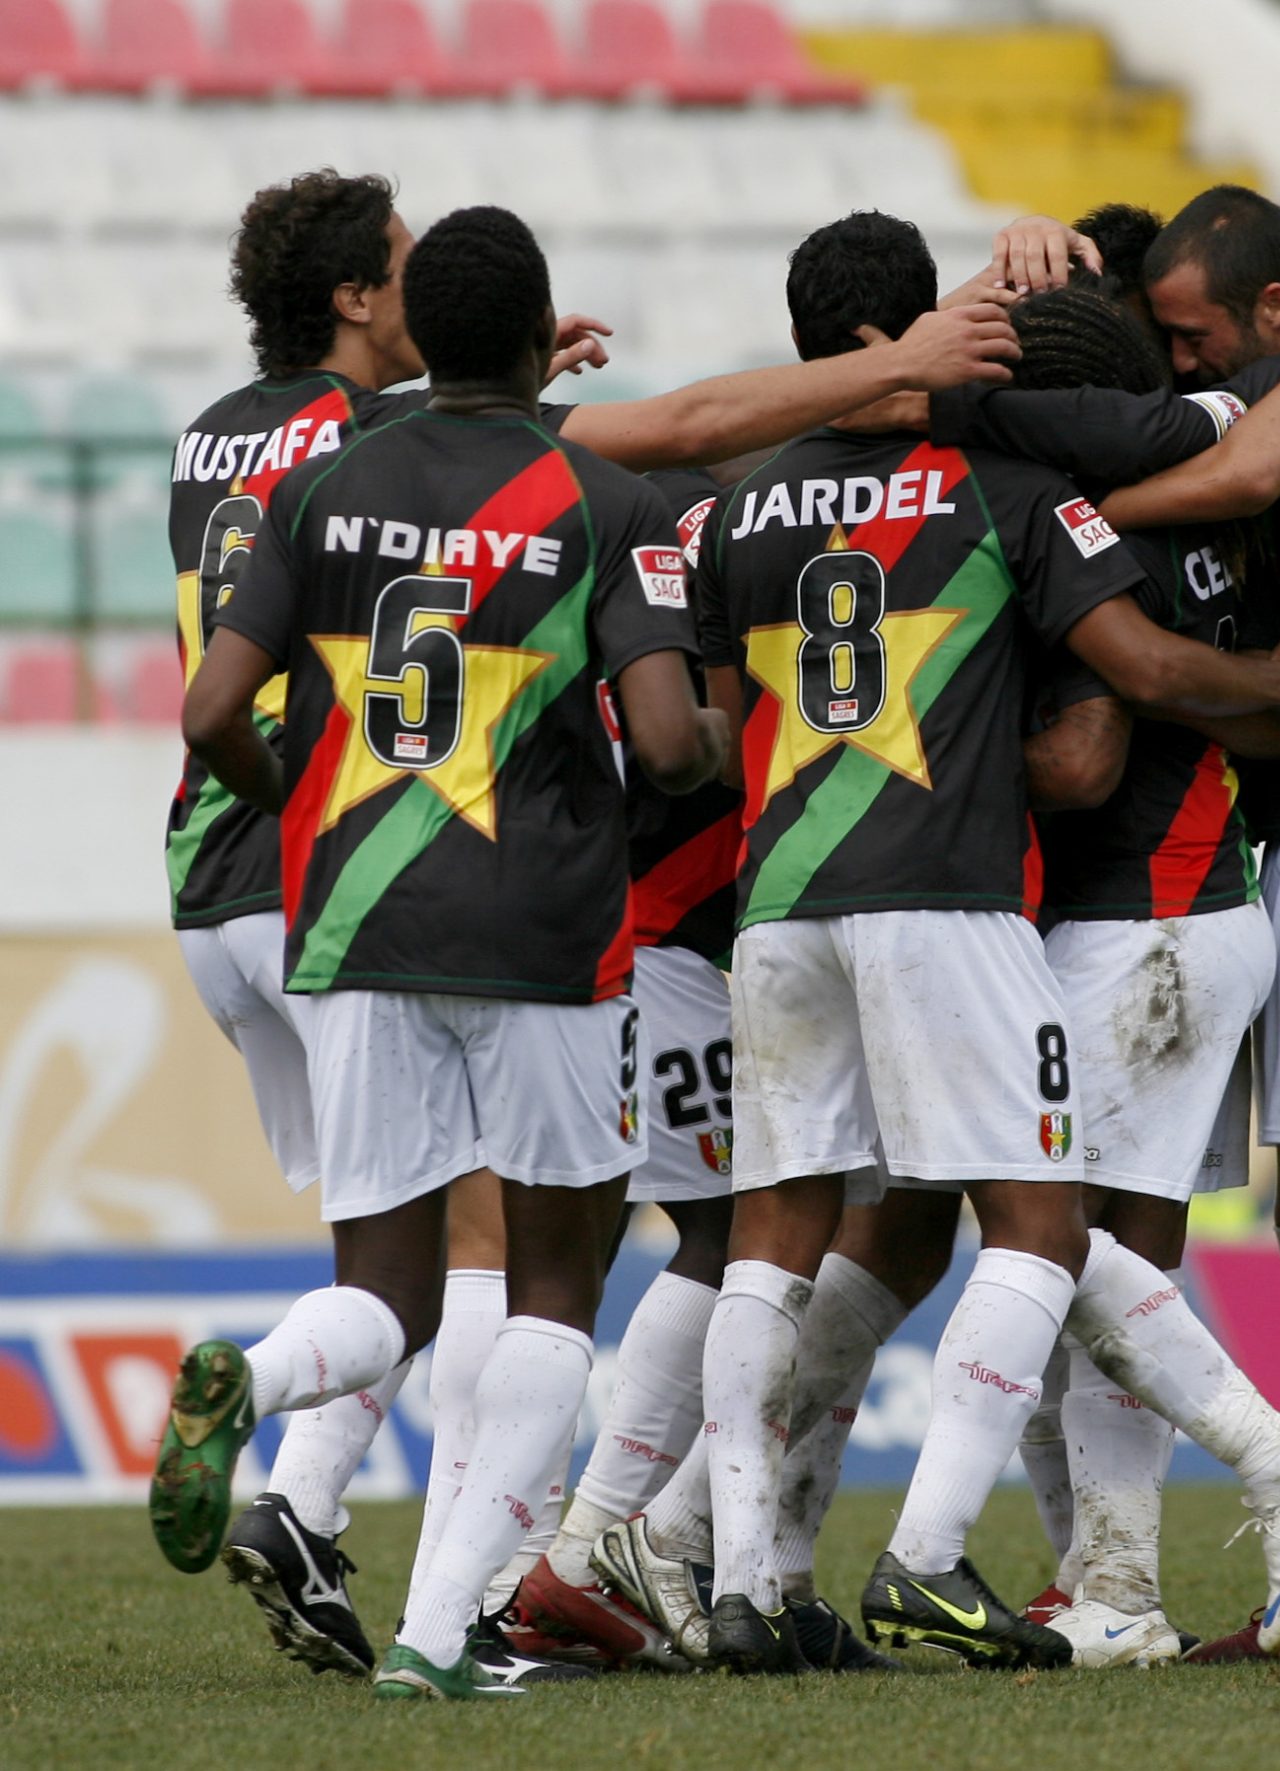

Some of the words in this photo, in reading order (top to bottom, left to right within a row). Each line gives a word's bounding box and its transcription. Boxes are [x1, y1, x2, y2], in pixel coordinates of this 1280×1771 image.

[172, 418, 341, 483] MUSTAFA
[731, 470, 957, 540] JARDEL
[1073, 502, 1097, 519] LIG
[655, 555, 683, 571] LIGA
[363, 573, 472, 770] 5
[796, 551, 885, 734] 8
[652, 1036, 733, 1131] 29
[1035, 1021, 1070, 1104] 8
